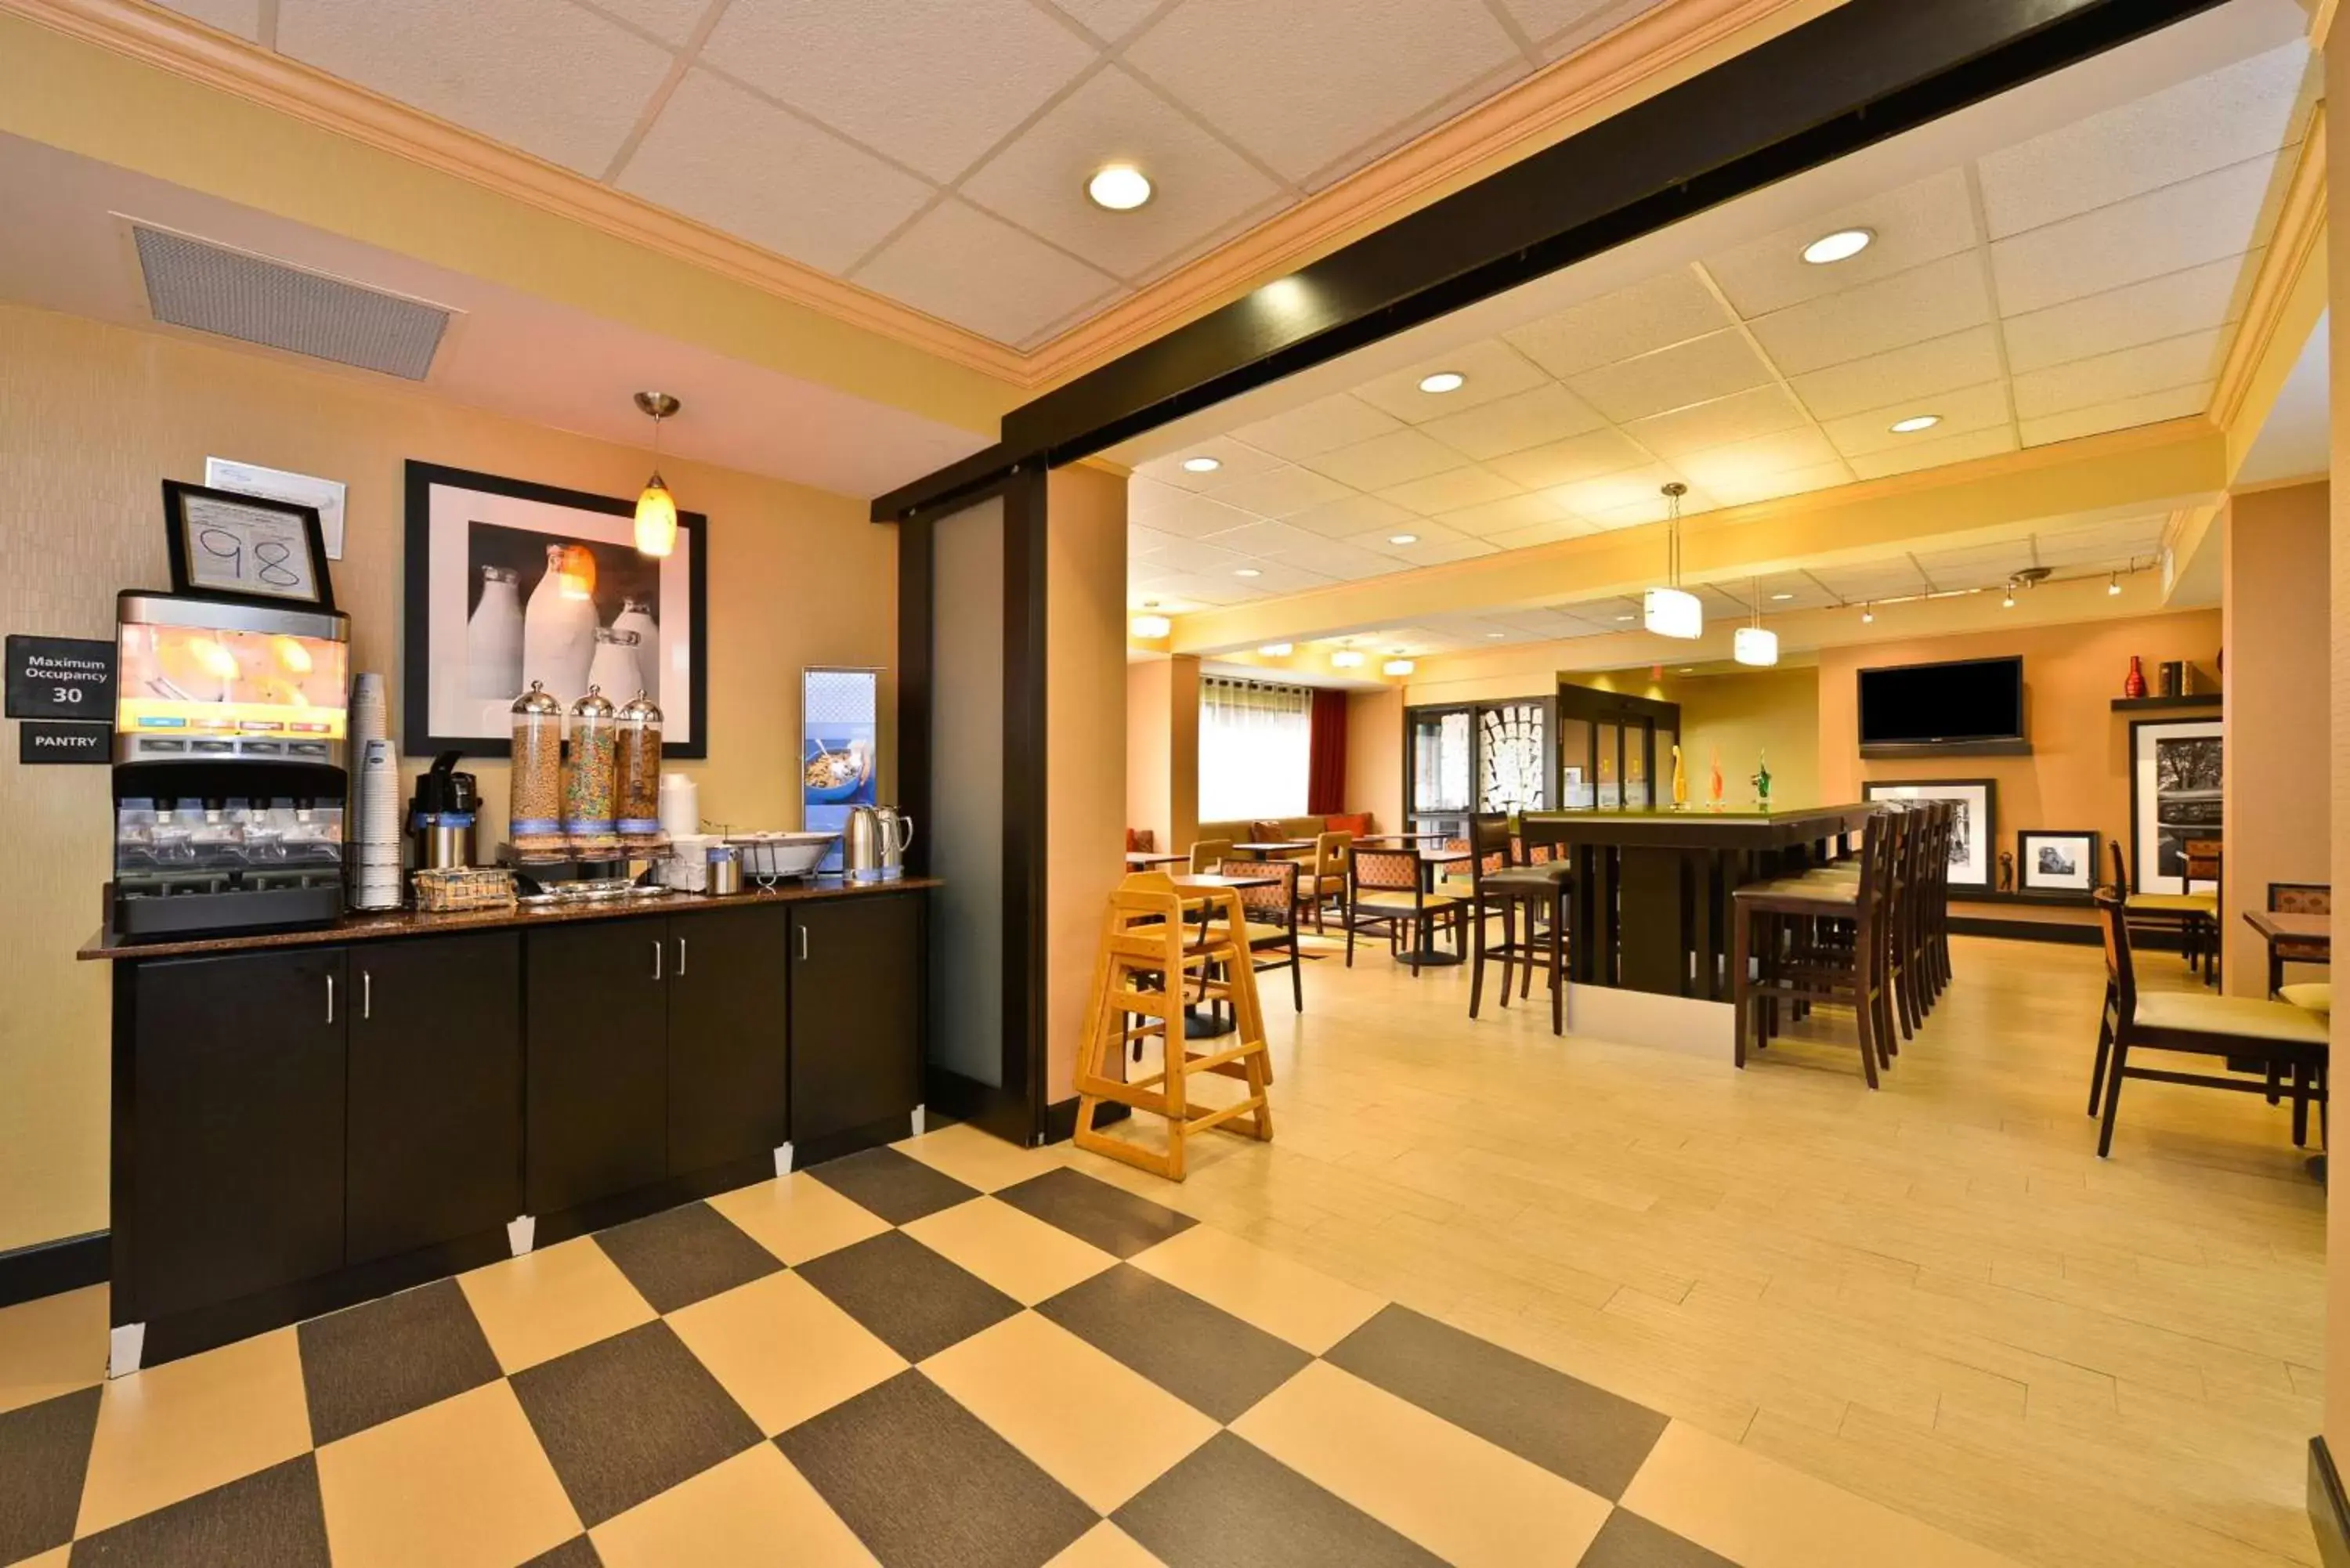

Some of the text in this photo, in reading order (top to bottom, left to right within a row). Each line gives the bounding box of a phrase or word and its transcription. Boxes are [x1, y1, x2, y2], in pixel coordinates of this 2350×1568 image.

[199, 528, 301, 587] 98
[28, 656, 106, 670] Maximum
[25, 667, 107, 684] Occupancy
[52, 687, 83, 703] 30
[35, 735, 97, 747] PANTRY
